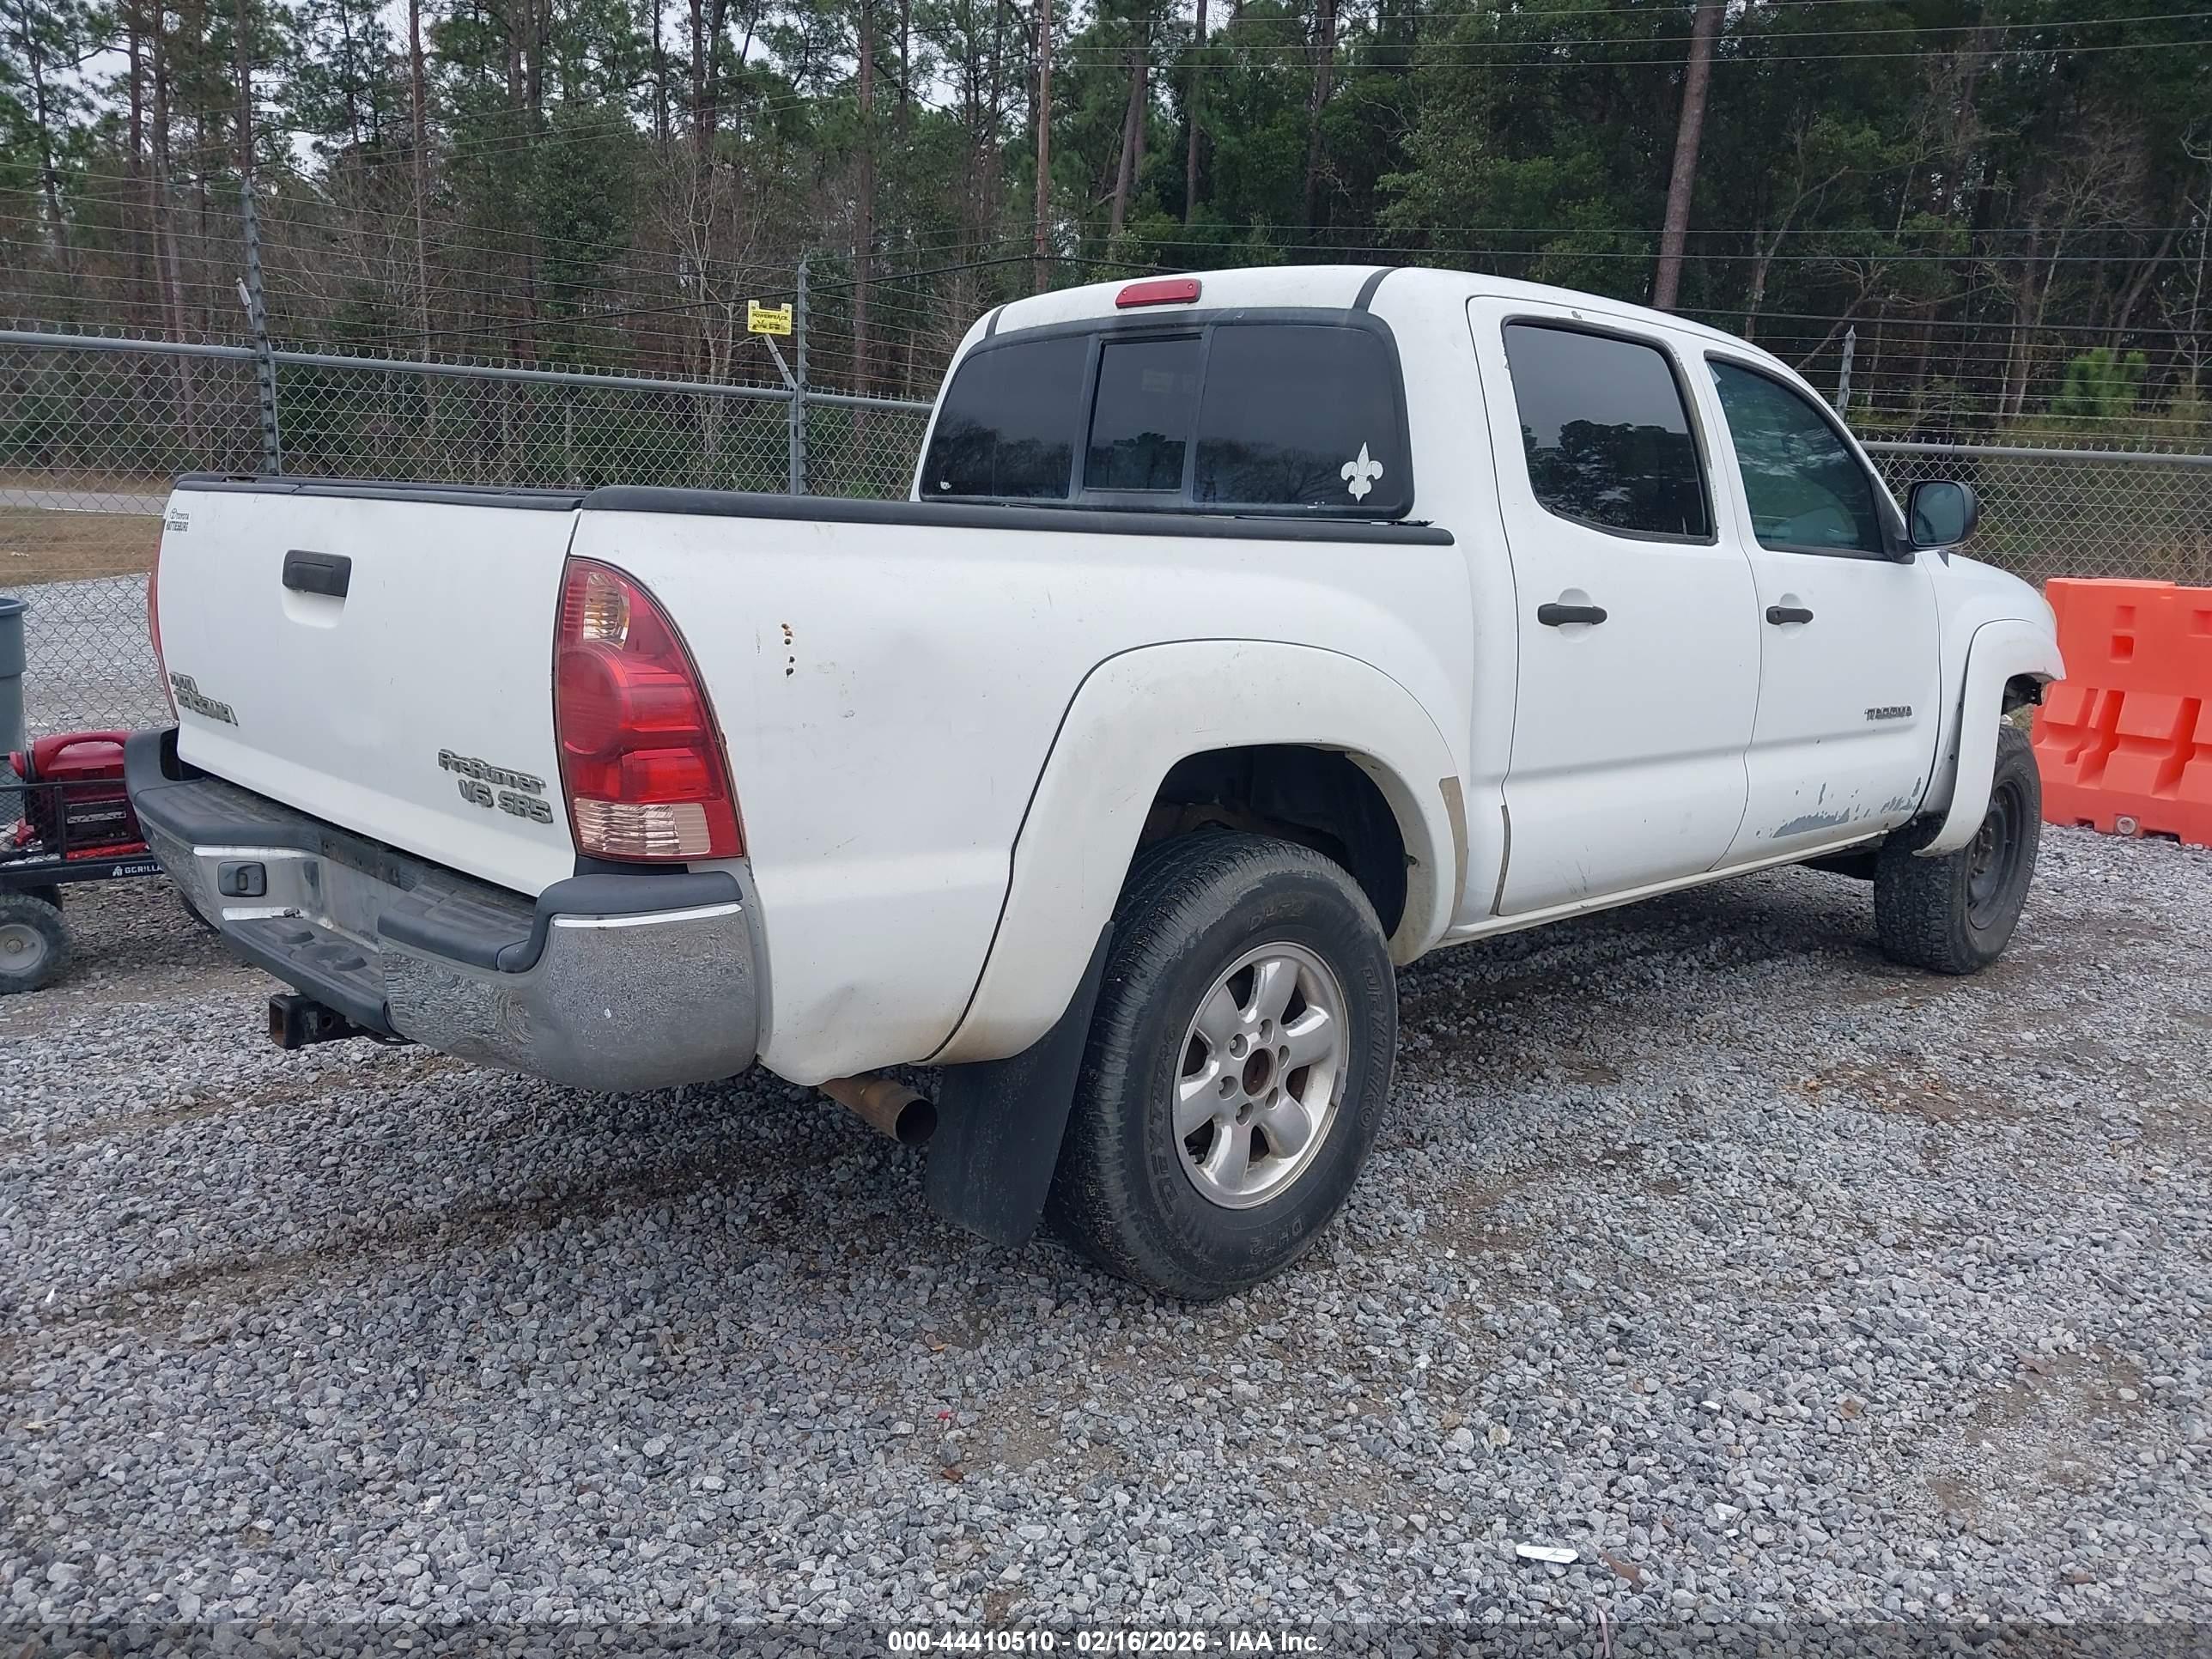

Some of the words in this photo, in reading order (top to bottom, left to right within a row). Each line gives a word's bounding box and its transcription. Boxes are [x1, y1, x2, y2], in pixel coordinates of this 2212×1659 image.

[1864, 706, 1913, 721] TACOMA
[457, 779, 495, 808] V6
[497, 790, 554, 823] SR5
[125, 865, 163, 874] GORILLA
